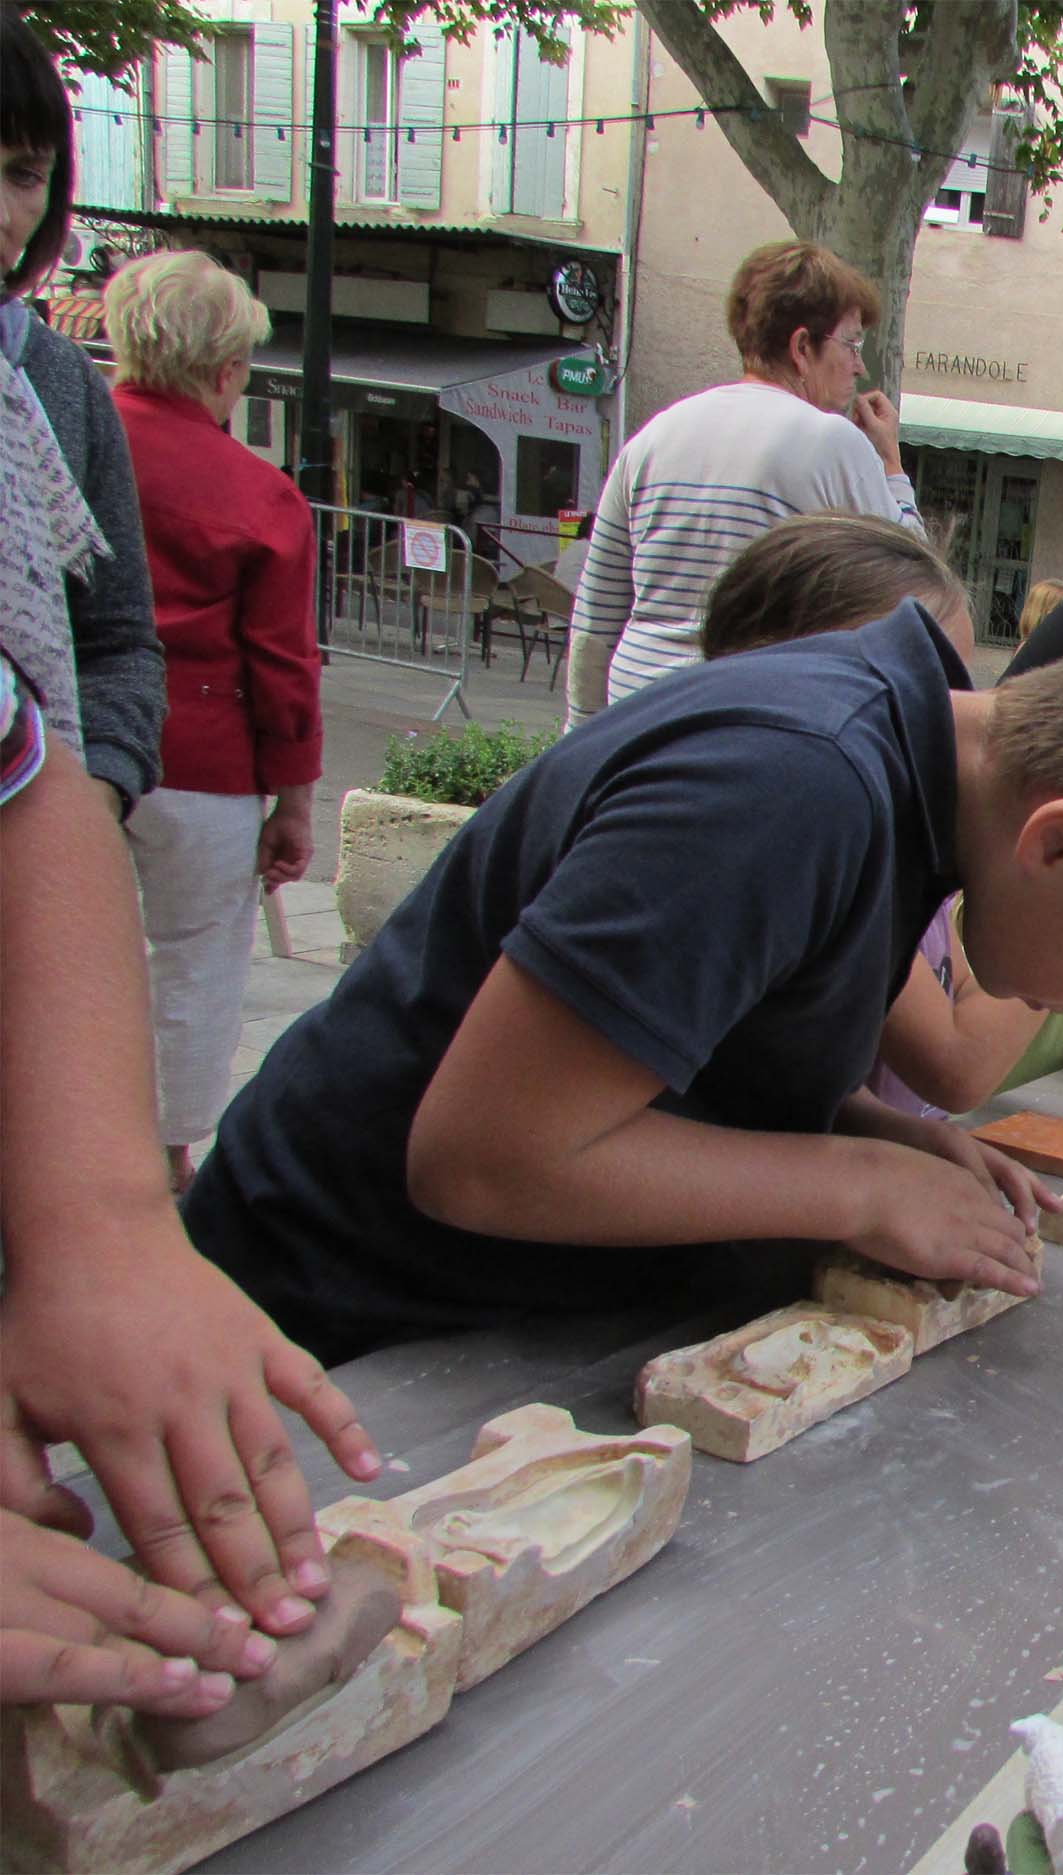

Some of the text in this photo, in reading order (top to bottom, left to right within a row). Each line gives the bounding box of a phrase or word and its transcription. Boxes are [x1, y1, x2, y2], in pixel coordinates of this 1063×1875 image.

[561, 368, 587, 384] PMU
[915, 351, 1029, 383] FARANDOLE
[267, 378, 302, 396] Snac
[487, 383, 588, 415] Snack Bar
[465, 398, 593, 436] Sandwichs Tapas
